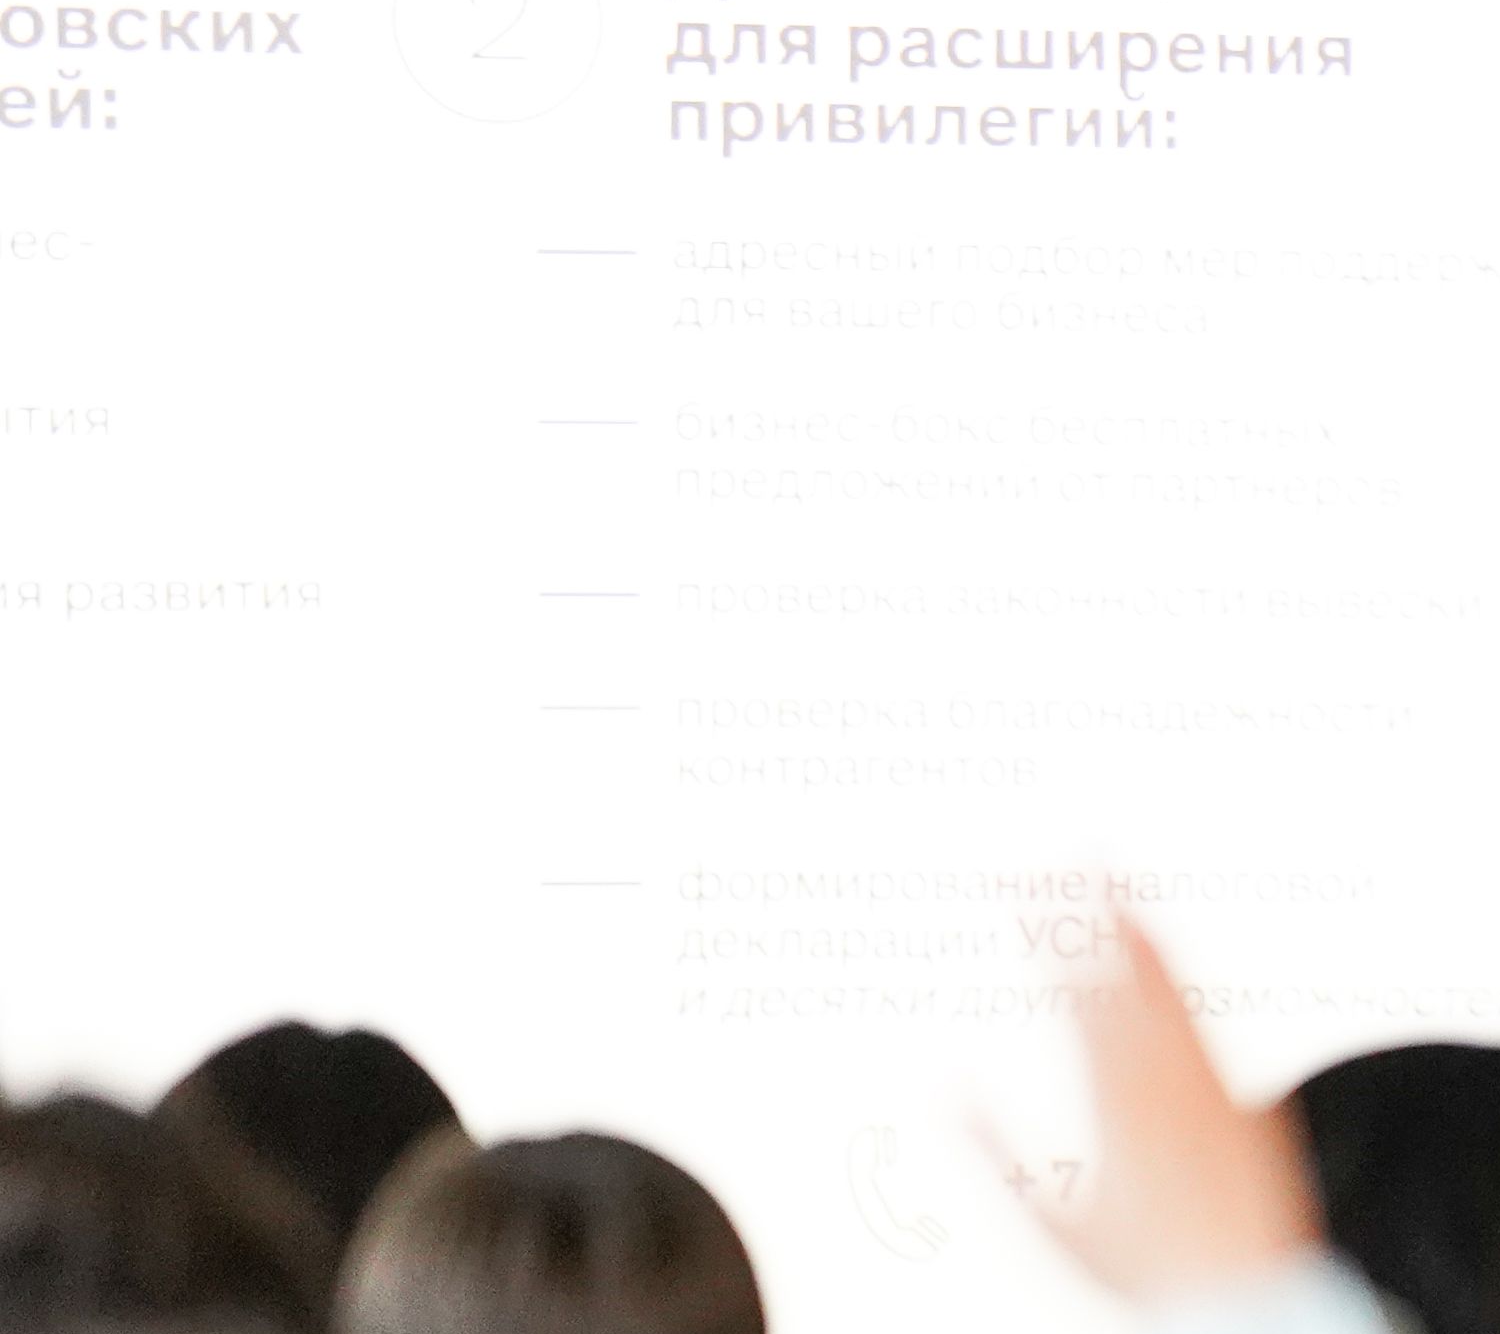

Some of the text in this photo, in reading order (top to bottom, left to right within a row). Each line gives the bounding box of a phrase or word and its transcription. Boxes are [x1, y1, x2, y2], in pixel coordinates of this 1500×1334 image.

[0, 4, 304, 55] овских
[664, 22, 1354, 85] для расширения
[0, 68, 118, 131] ей:
[669, 83, 1178, 158] привилегий:
[65, 581, 321, 621] развития
